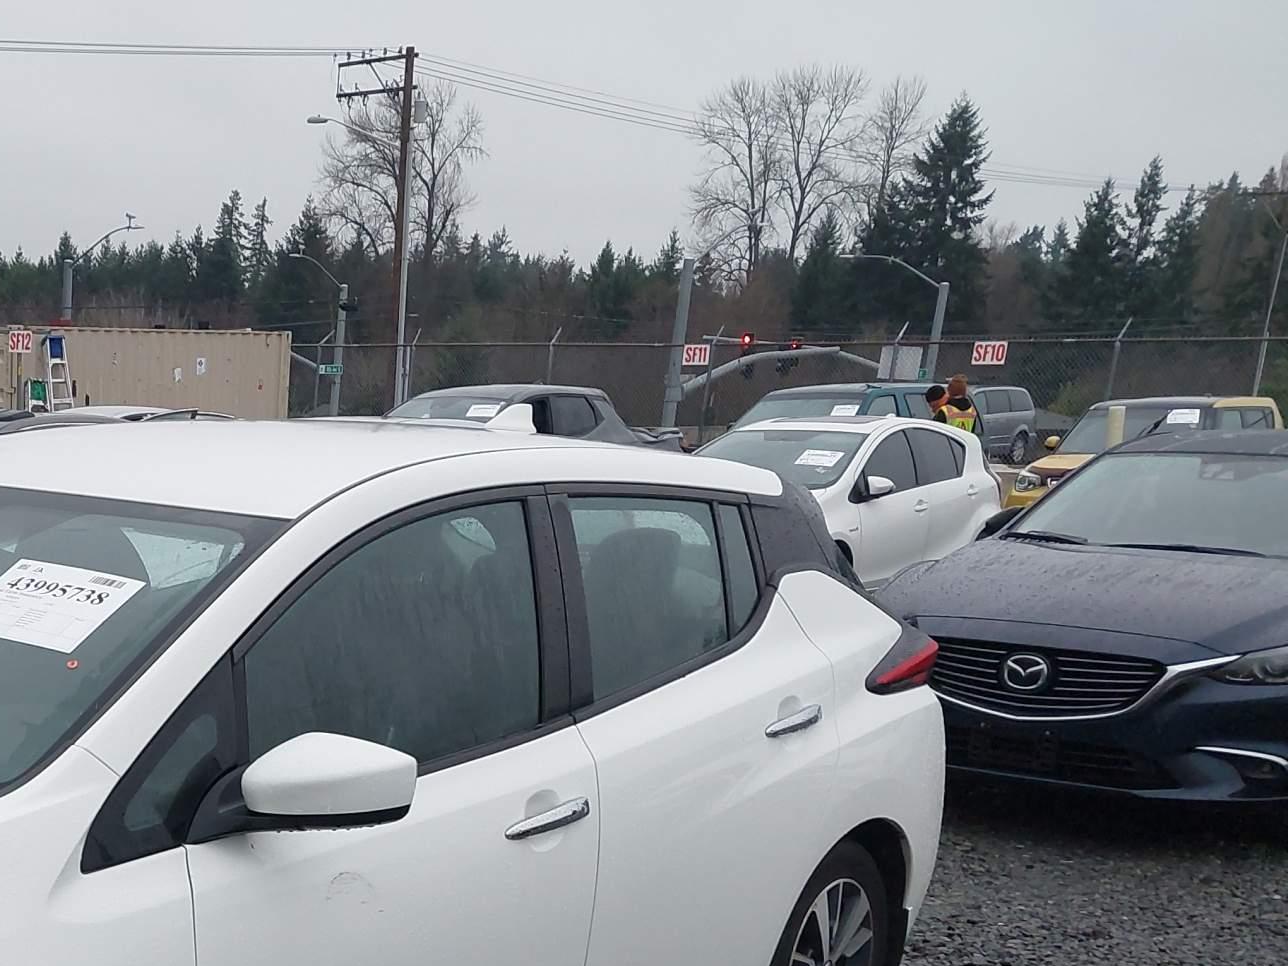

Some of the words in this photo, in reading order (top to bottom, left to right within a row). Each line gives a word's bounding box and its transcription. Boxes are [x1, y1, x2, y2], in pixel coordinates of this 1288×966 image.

[9, 332, 32, 351] SF12
[684, 346, 708, 363] SF11
[973, 343, 1007, 362] SF10
[6, 576, 111, 607] 43995738
